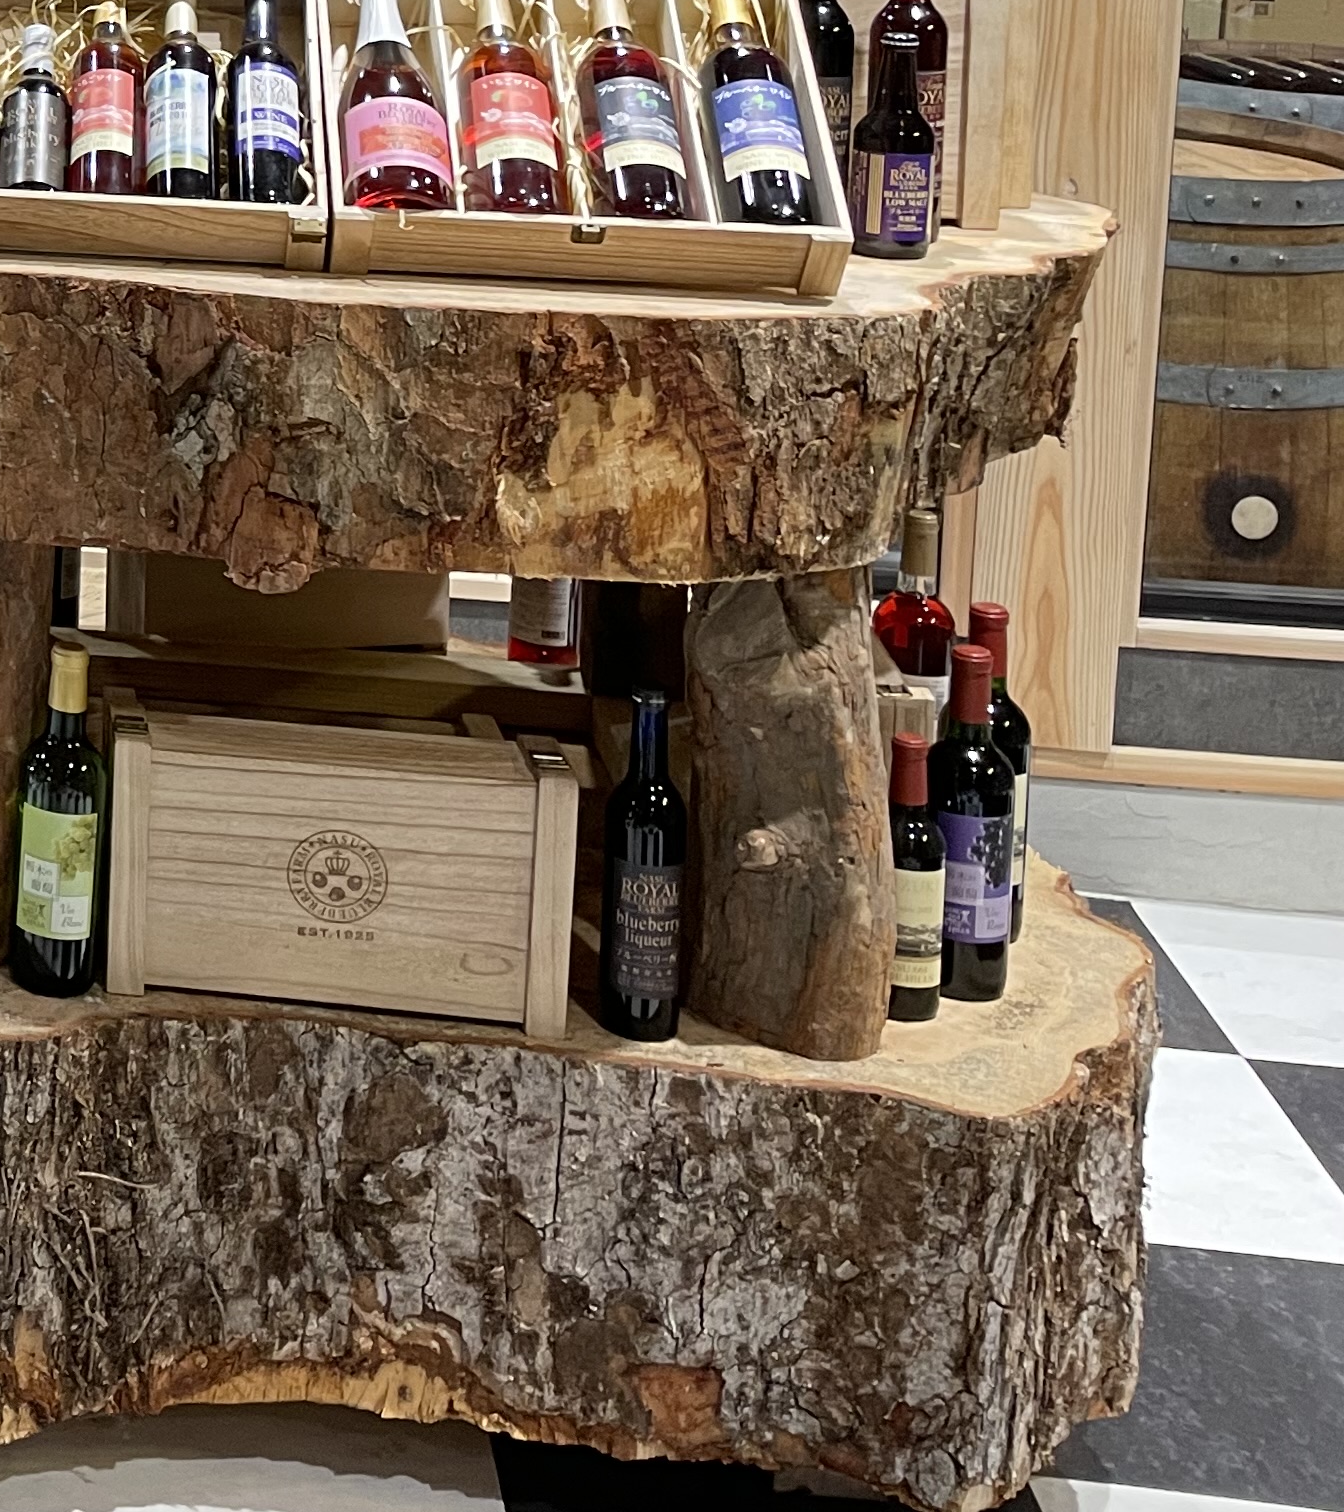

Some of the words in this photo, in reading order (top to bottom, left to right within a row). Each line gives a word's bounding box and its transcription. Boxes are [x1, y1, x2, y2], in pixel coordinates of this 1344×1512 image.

[891, 169, 926, 181] ROYAL
[317, 834, 360, 848] NASU
[622, 877, 679, 898] ROYAL
[625, 928, 673, 948] liqueur
